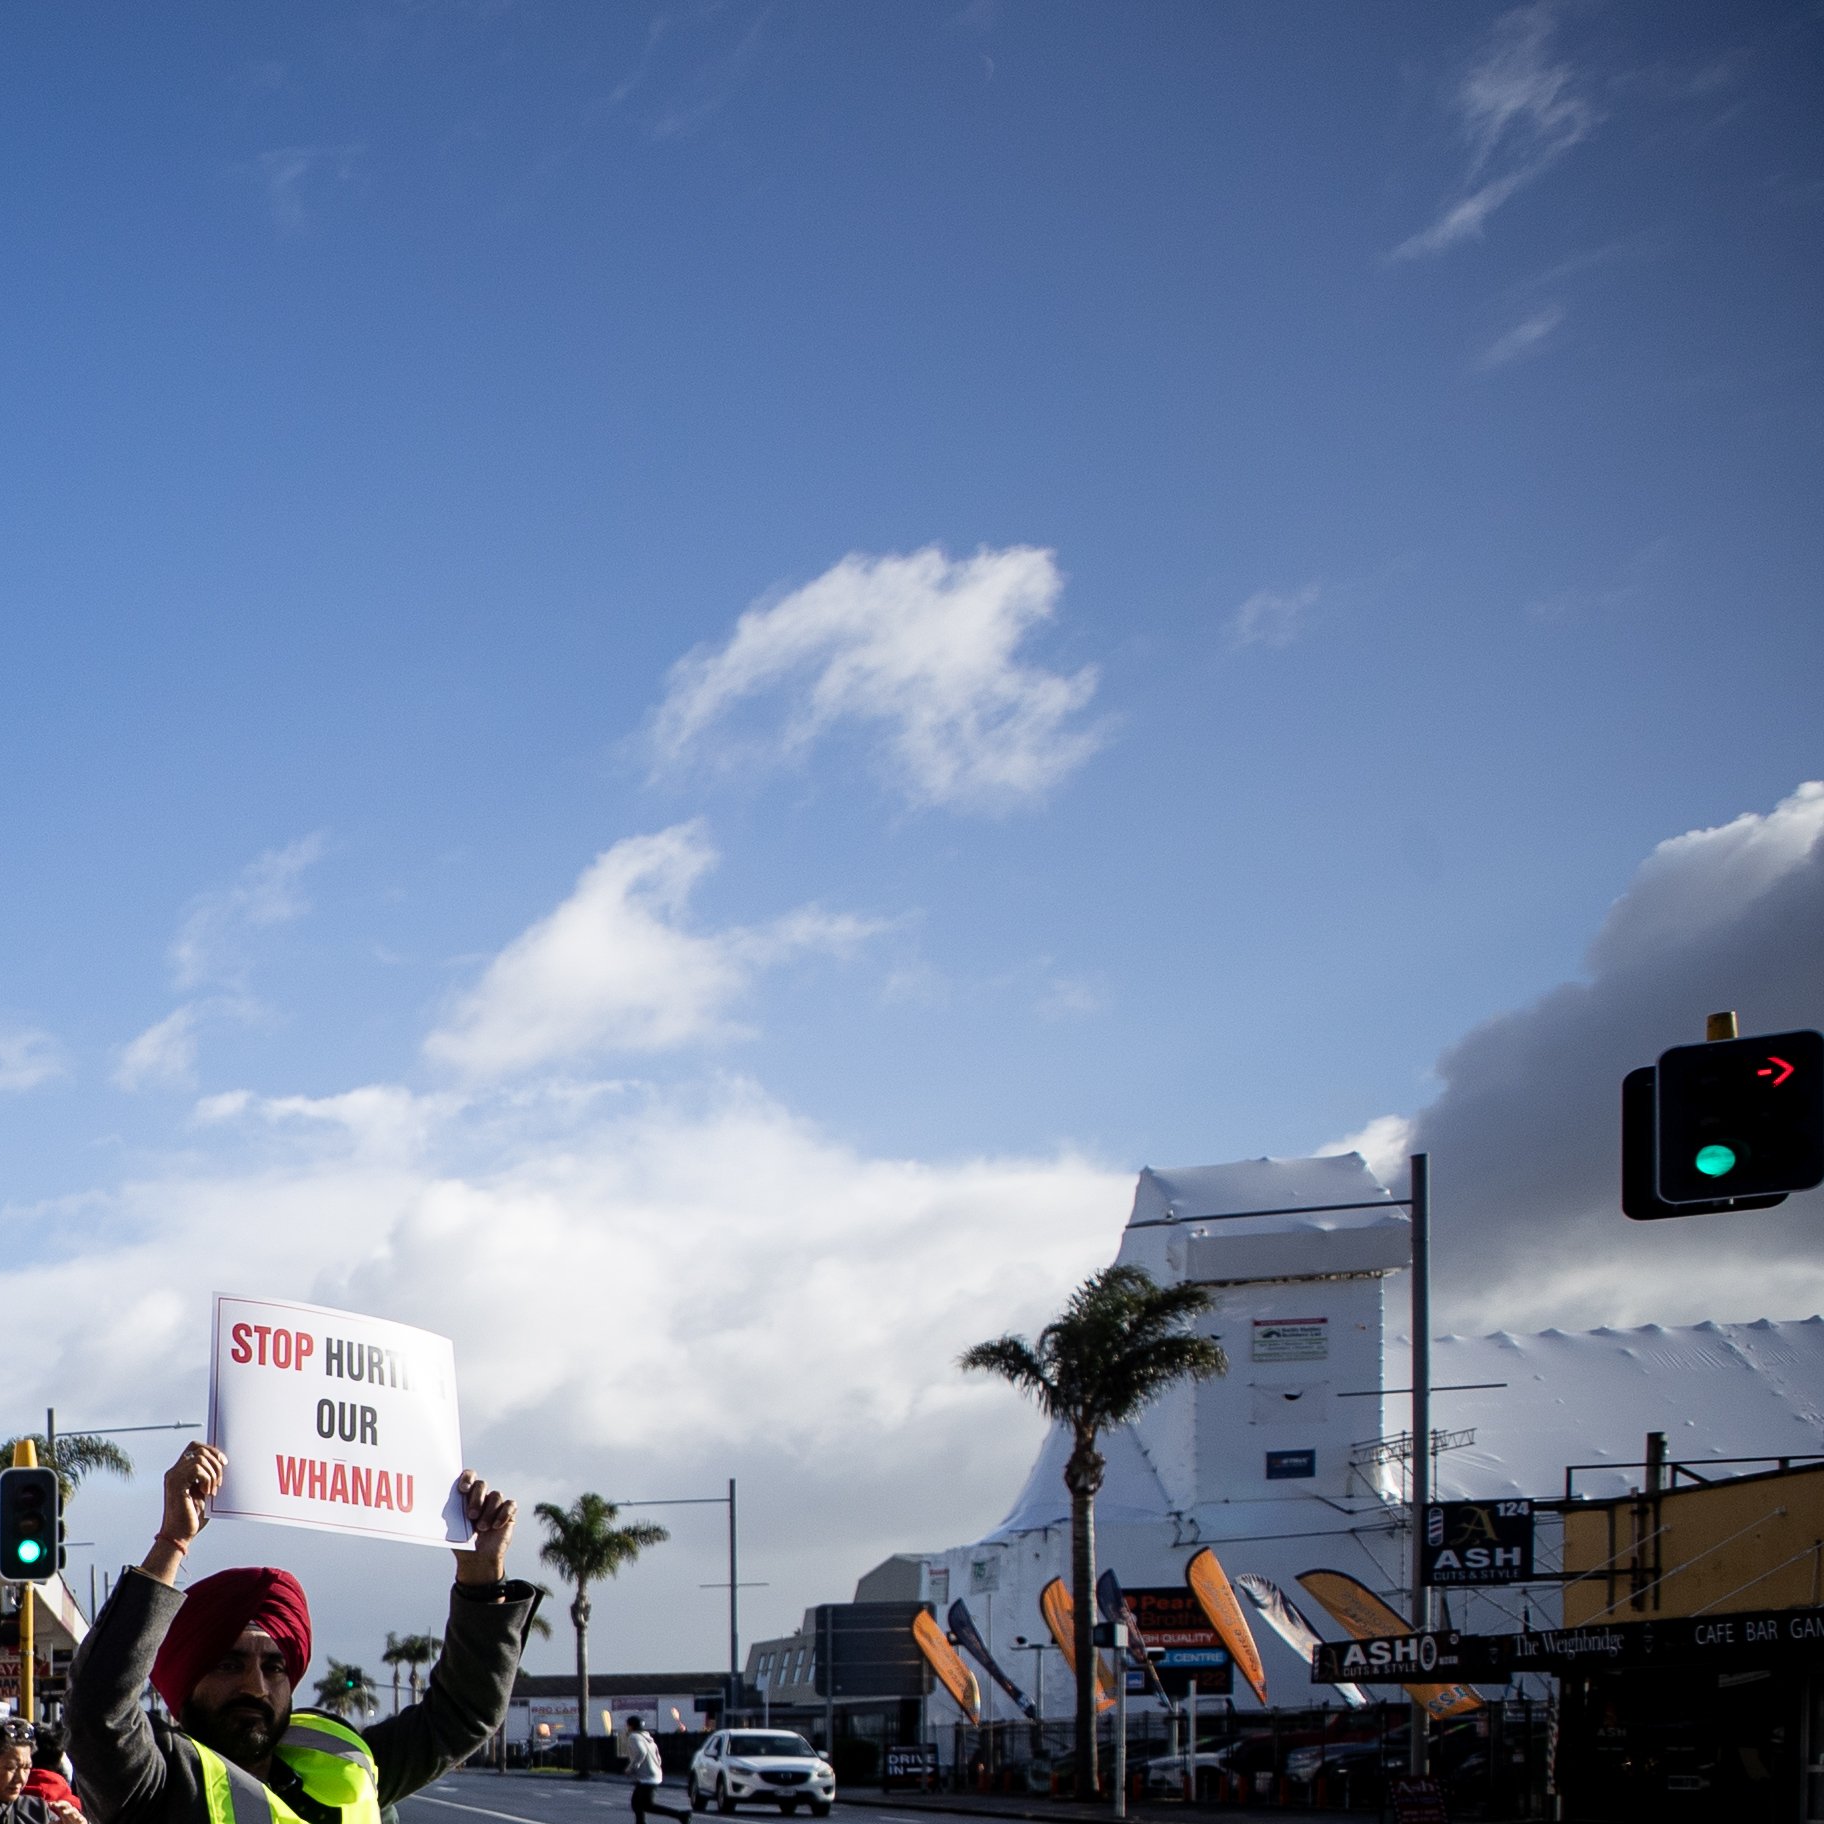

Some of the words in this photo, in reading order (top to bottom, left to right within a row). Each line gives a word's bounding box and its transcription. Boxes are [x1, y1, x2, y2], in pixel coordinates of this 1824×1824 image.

[231, 1322, 314, 1371] STOP
[316, 1398, 378, 1446] OUR
[276, 1455, 415, 1514] WHĀNAU
[1498, 1502, 1530, 1516] 124
[1434, 1547, 1522, 1569] ASH
[1480, 1567, 1521, 1579] STYLE
[1162, 1633, 1214, 1644] QUALITY
[1695, 1623, 1735, 1645] CAFE
[1746, 1620, 1778, 1642] BAR
[1343, 1638, 1418, 1667] ASH
[1513, 1634, 1539, 1657] The
[1542, 1628, 1625, 1661] Weighbridge
[1174, 1652, 1224, 1663] CENTRE
[888, 1753, 936, 1765] DRIVE
[889, 1765, 904, 1776] IN
